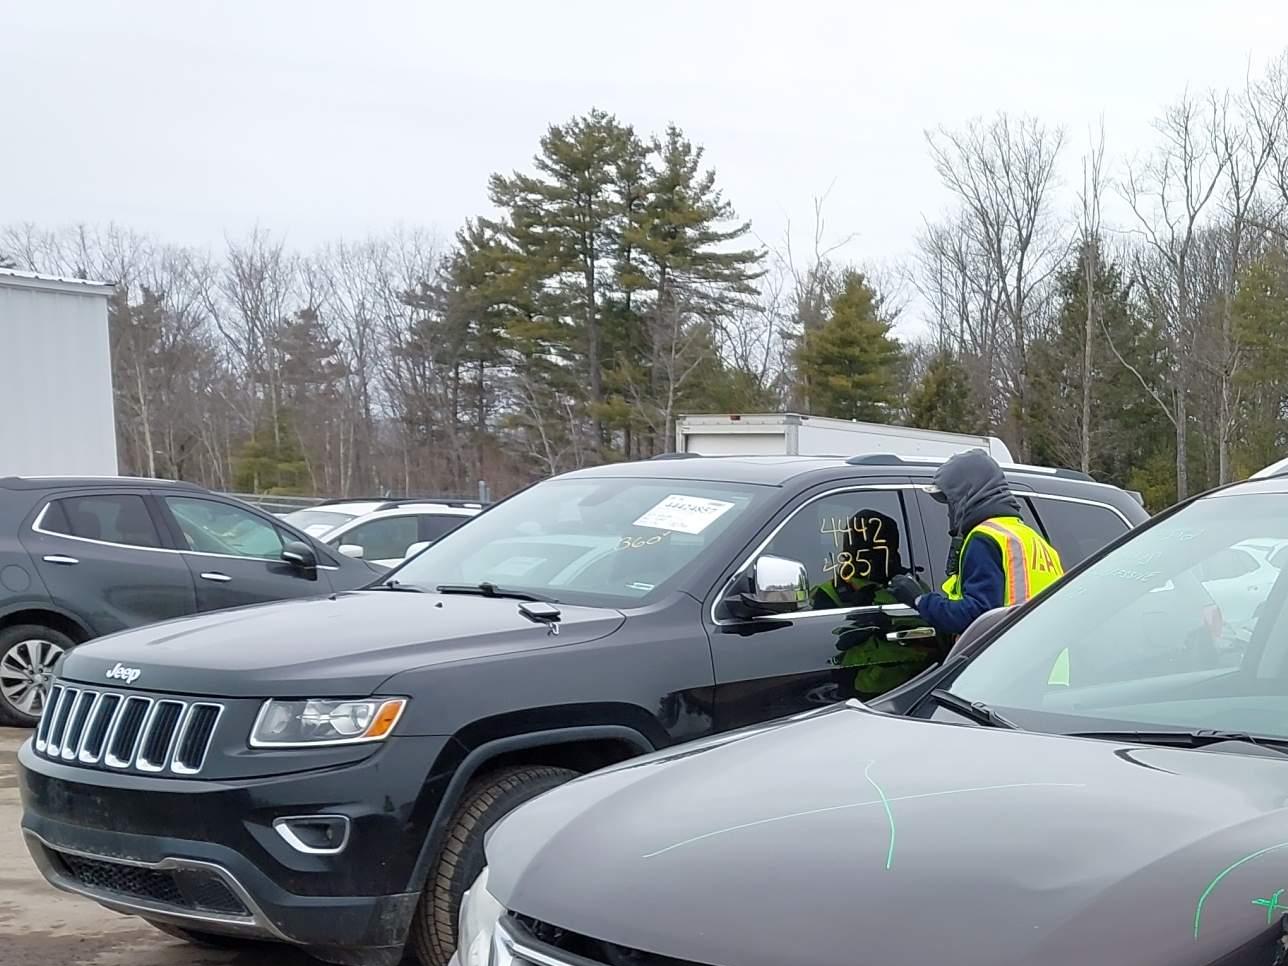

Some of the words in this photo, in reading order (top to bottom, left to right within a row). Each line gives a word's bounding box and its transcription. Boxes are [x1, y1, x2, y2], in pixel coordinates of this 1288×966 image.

[820, 515, 887, 547] 4442
[822, 545, 889, 588] 4857
[105, 662, 141, 685] Jeep
